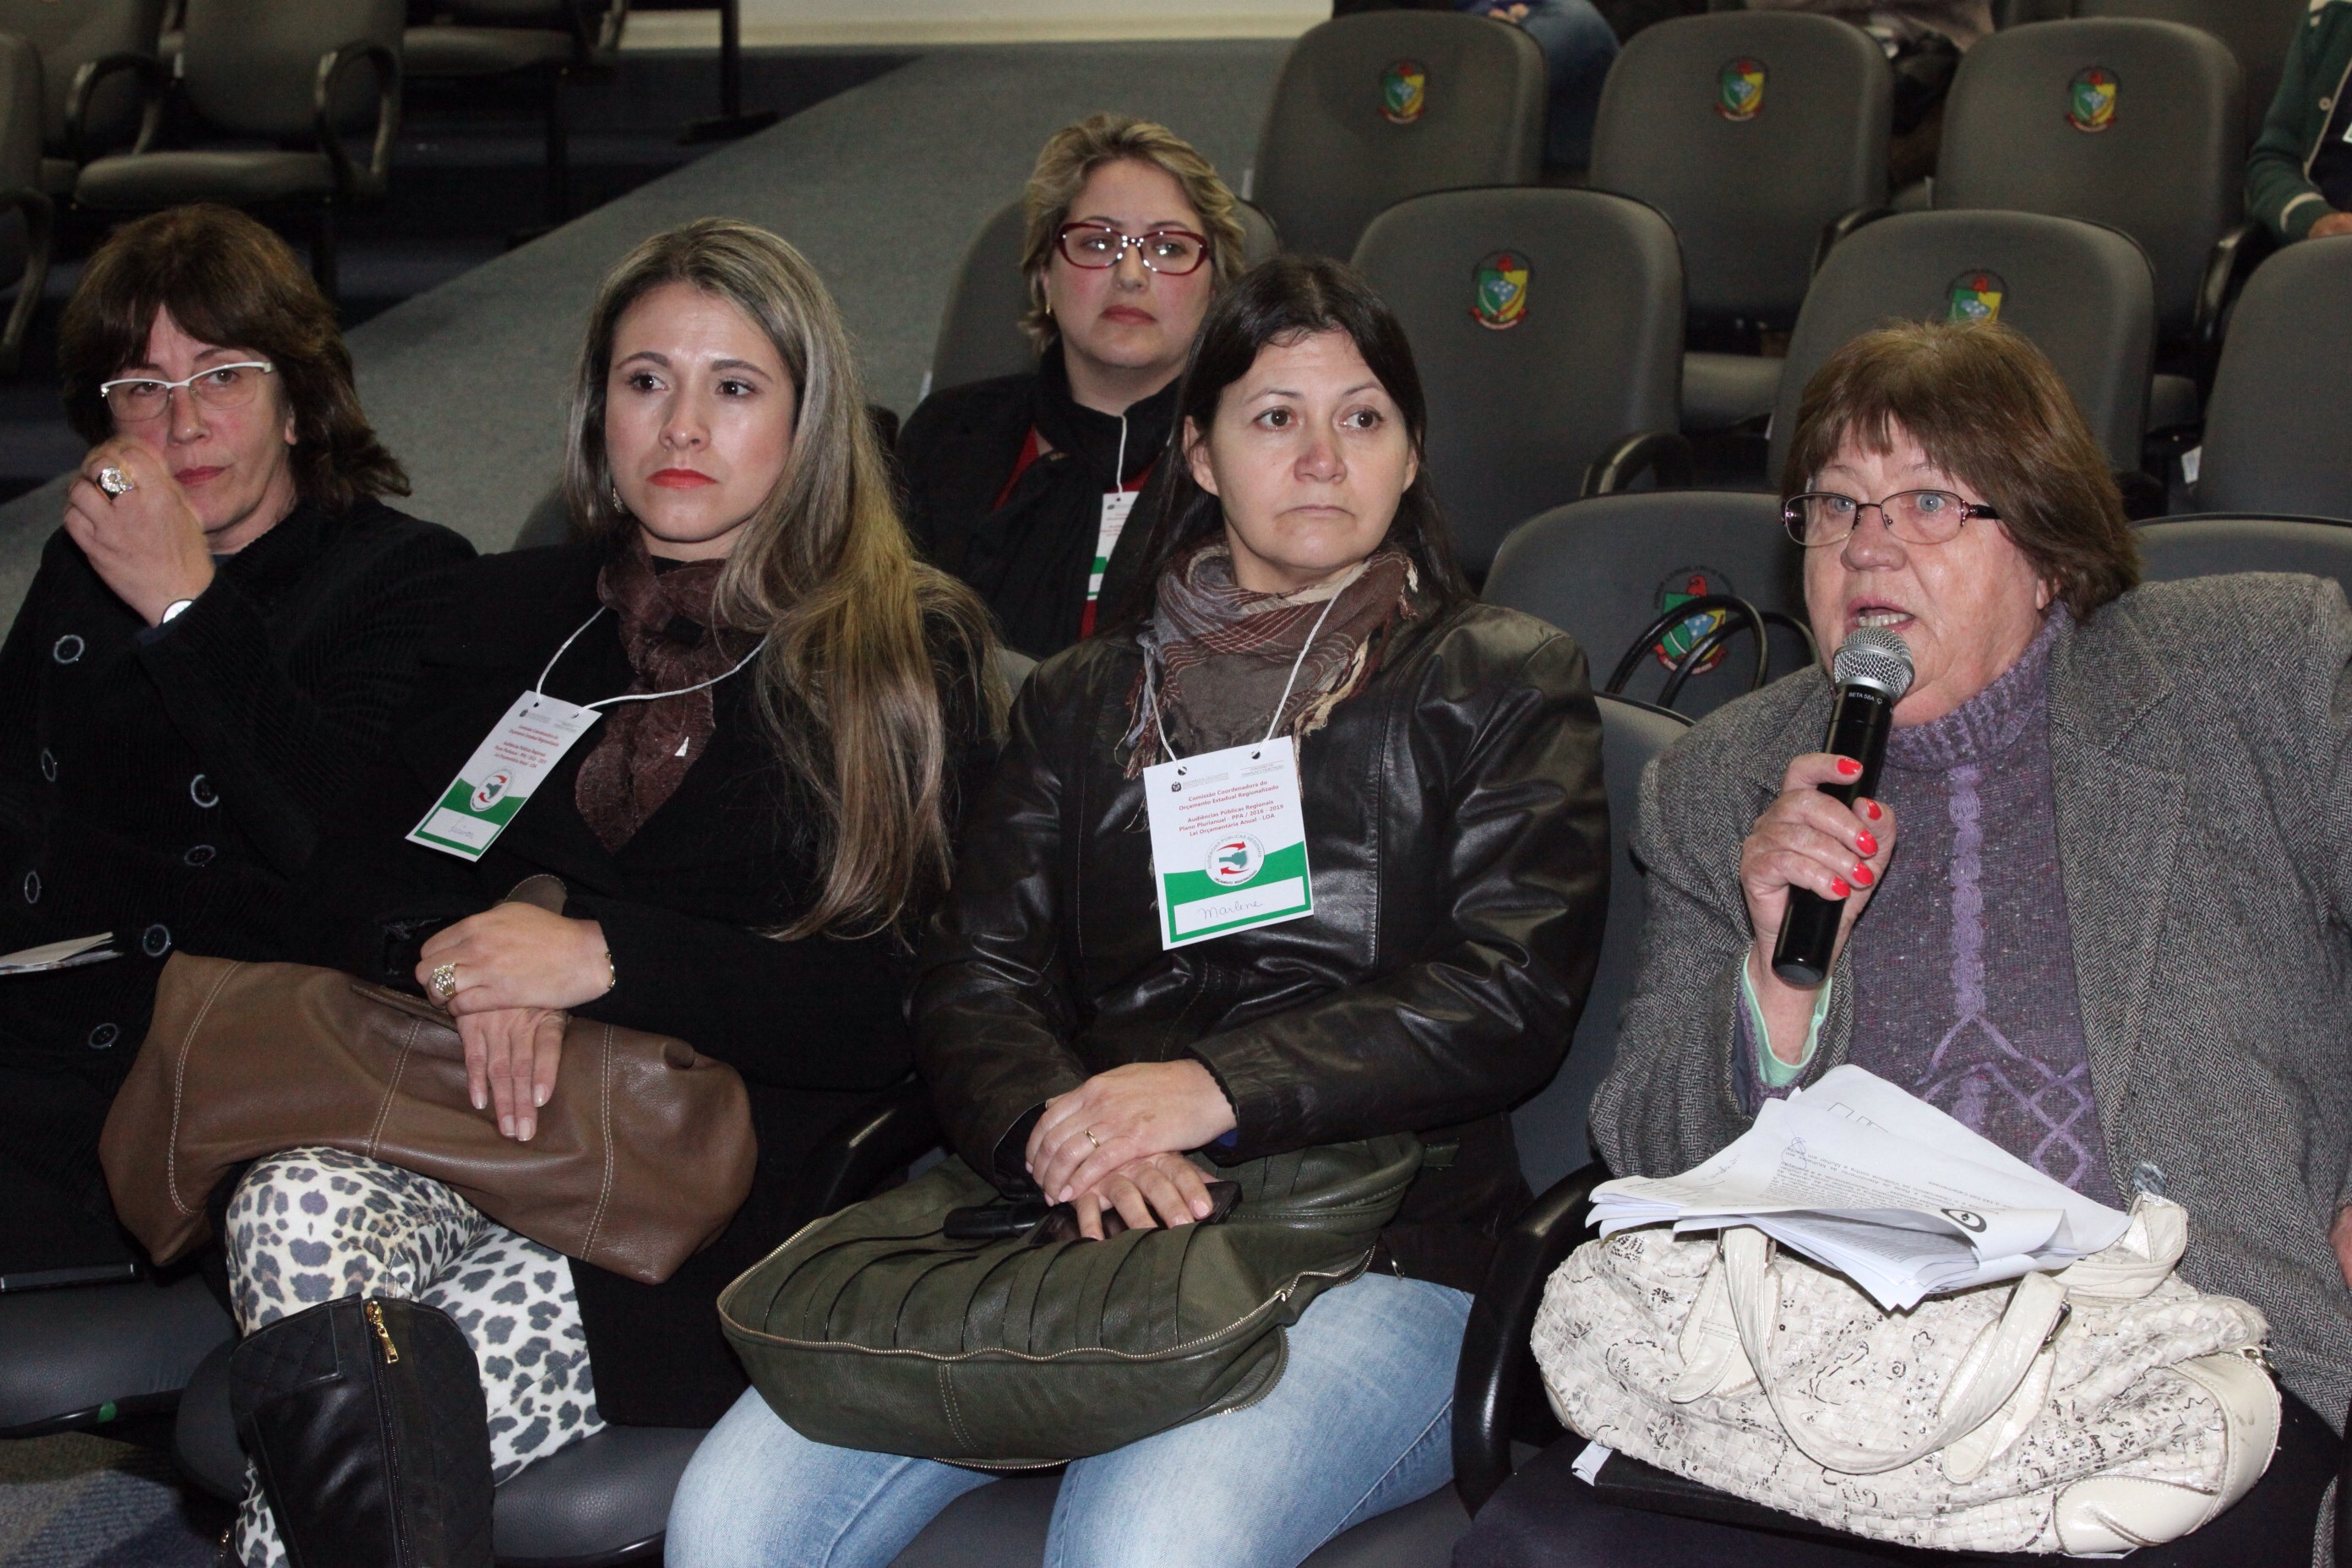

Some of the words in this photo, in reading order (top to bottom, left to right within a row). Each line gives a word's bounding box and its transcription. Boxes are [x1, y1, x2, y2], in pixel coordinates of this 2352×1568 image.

[1179, 800, 1211, 810] Orçamento
[1213, 794, 1236, 803] Estadual
[1239, 785, 1278, 798] Regionalizado
[1189, 792, 1216, 801] Comissão
[1217, 783, 1258, 795] Coordenadora
[1188, 812, 1218, 823] Audiências
[1221, 806, 1244, 815] Públicas
[1245, 800, 1273, 809] Regionais
[1197, 817, 1226, 827] Plurianual
[1200, 822, 1238, 835] Orçamentária
[1198, 901, 1263, 919] Marlene
